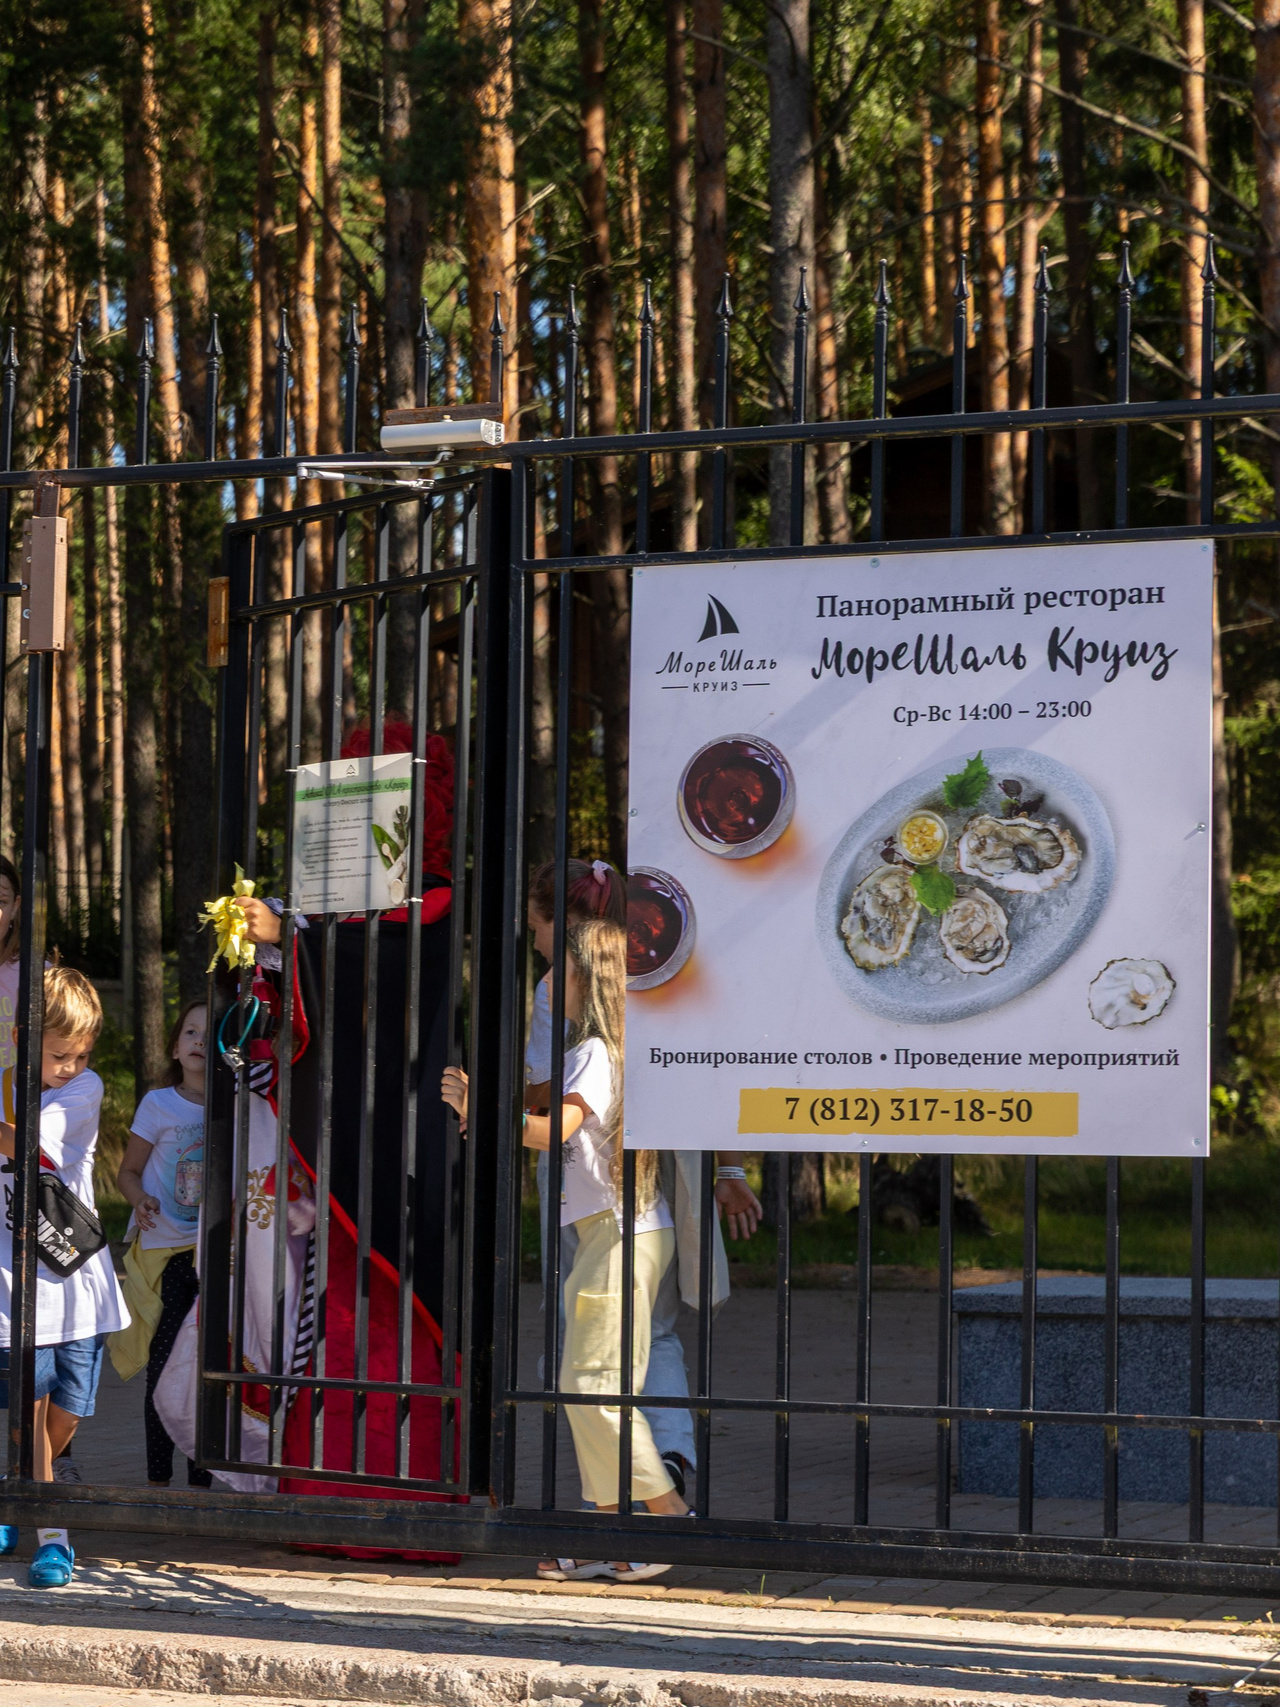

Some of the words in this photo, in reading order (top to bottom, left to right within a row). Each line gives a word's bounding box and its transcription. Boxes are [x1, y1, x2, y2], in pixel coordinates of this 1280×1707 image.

[815, 587, 1016, 621] Панорамный
[1023, 586, 1166, 616] ресторан
[655, 648, 778, 679] МореШаль
[810, 633, 1027, 684] МореШаль
[1046, 625, 1179, 684] Круиз
[692, 680, 738, 693] КРУИЗ
[893, 705, 952, 727] Ср-Вс
[958, 702, 1013, 721] 14:00
[1035, 700, 1092, 719] 23:00
[648, 1047, 798, 1069] Бронирование
[803, 1052, 873, 1065] столов
[894, 1048, 1022, 1070] Проведение
[1028, 1048, 1180, 1071] мероприятий
[785, 1097, 800, 1120] 7
[809, 1097, 880, 1127] (812)
[890, 1097, 1033, 1123] 317-18-50
